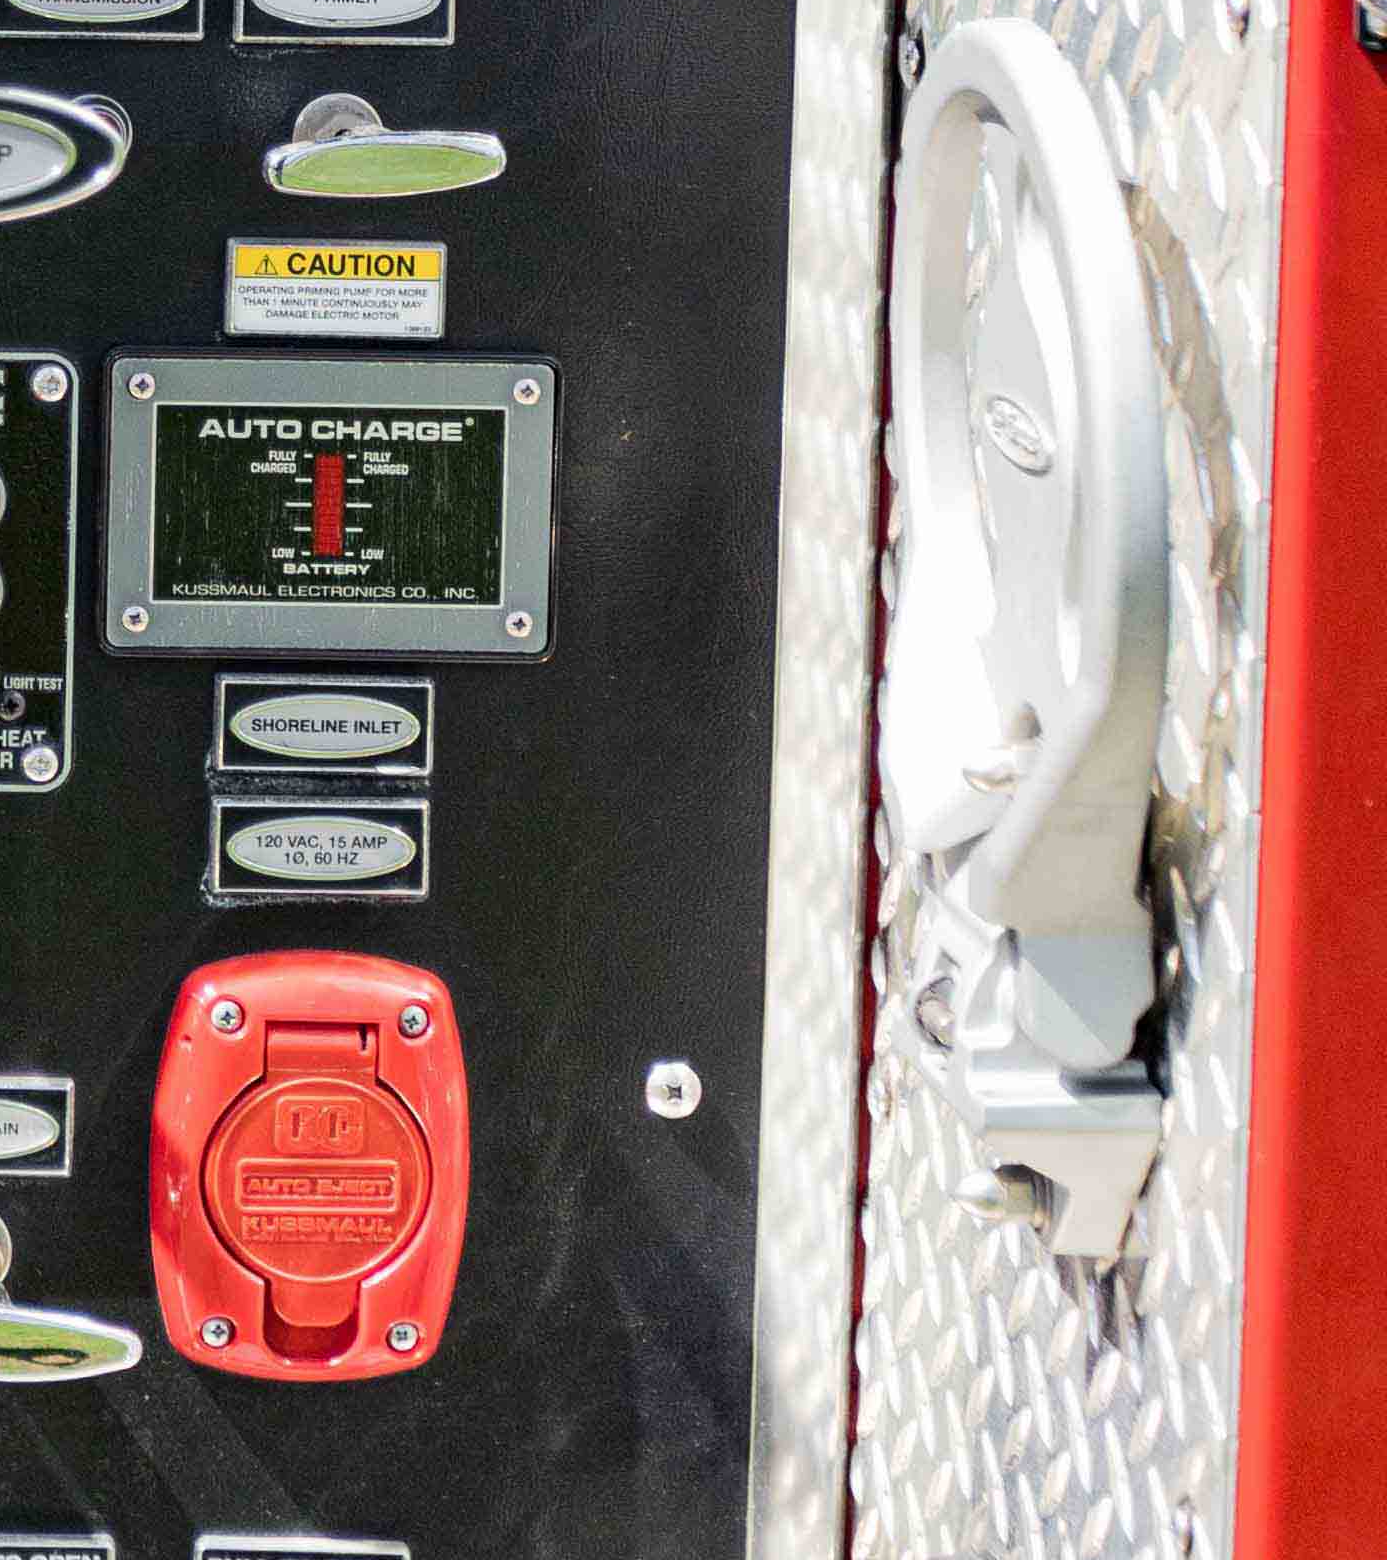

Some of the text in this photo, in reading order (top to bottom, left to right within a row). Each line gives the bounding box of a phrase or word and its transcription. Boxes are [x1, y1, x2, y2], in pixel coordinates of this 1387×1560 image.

[287, 253, 416, 277] CAUTION
[199, 419, 462, 441] AUTO CHARGE
[283, 564, 371, 576] BATTERY
[172, 584, 396, 599] KUSSMAUL ELECTRONICS
[251, 719, 401, 733] SHORELINE INLET
[255, 835, 388, 852] 120 VAC, 15 AMP
